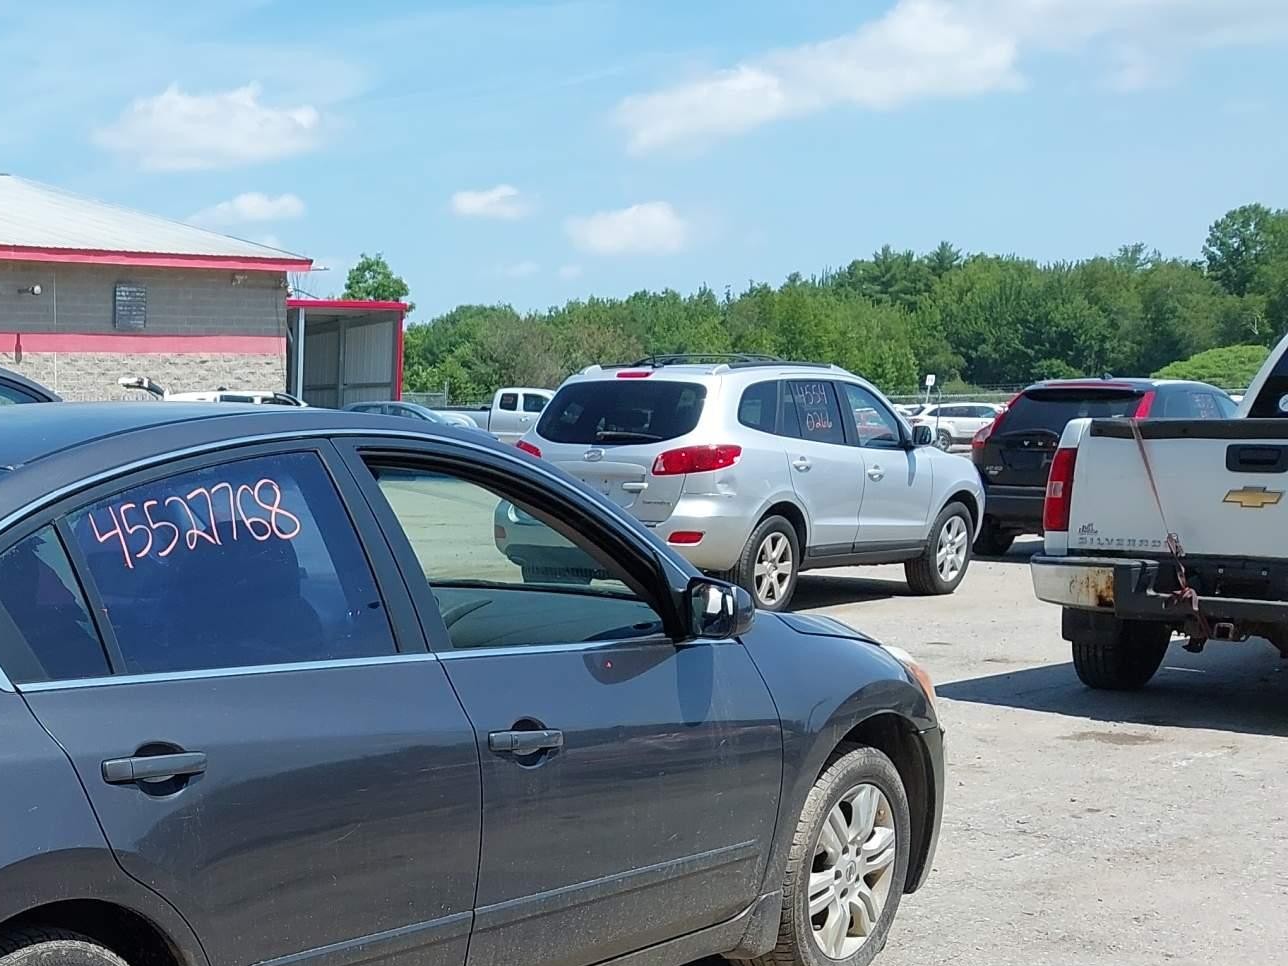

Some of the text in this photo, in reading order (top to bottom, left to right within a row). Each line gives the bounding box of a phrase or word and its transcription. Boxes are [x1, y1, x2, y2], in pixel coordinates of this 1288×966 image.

[795, 384, 828, 406] 4554
[88, 478, 301, 568] 45527768
[1078, 536, 1169, 548] SILVERAD
